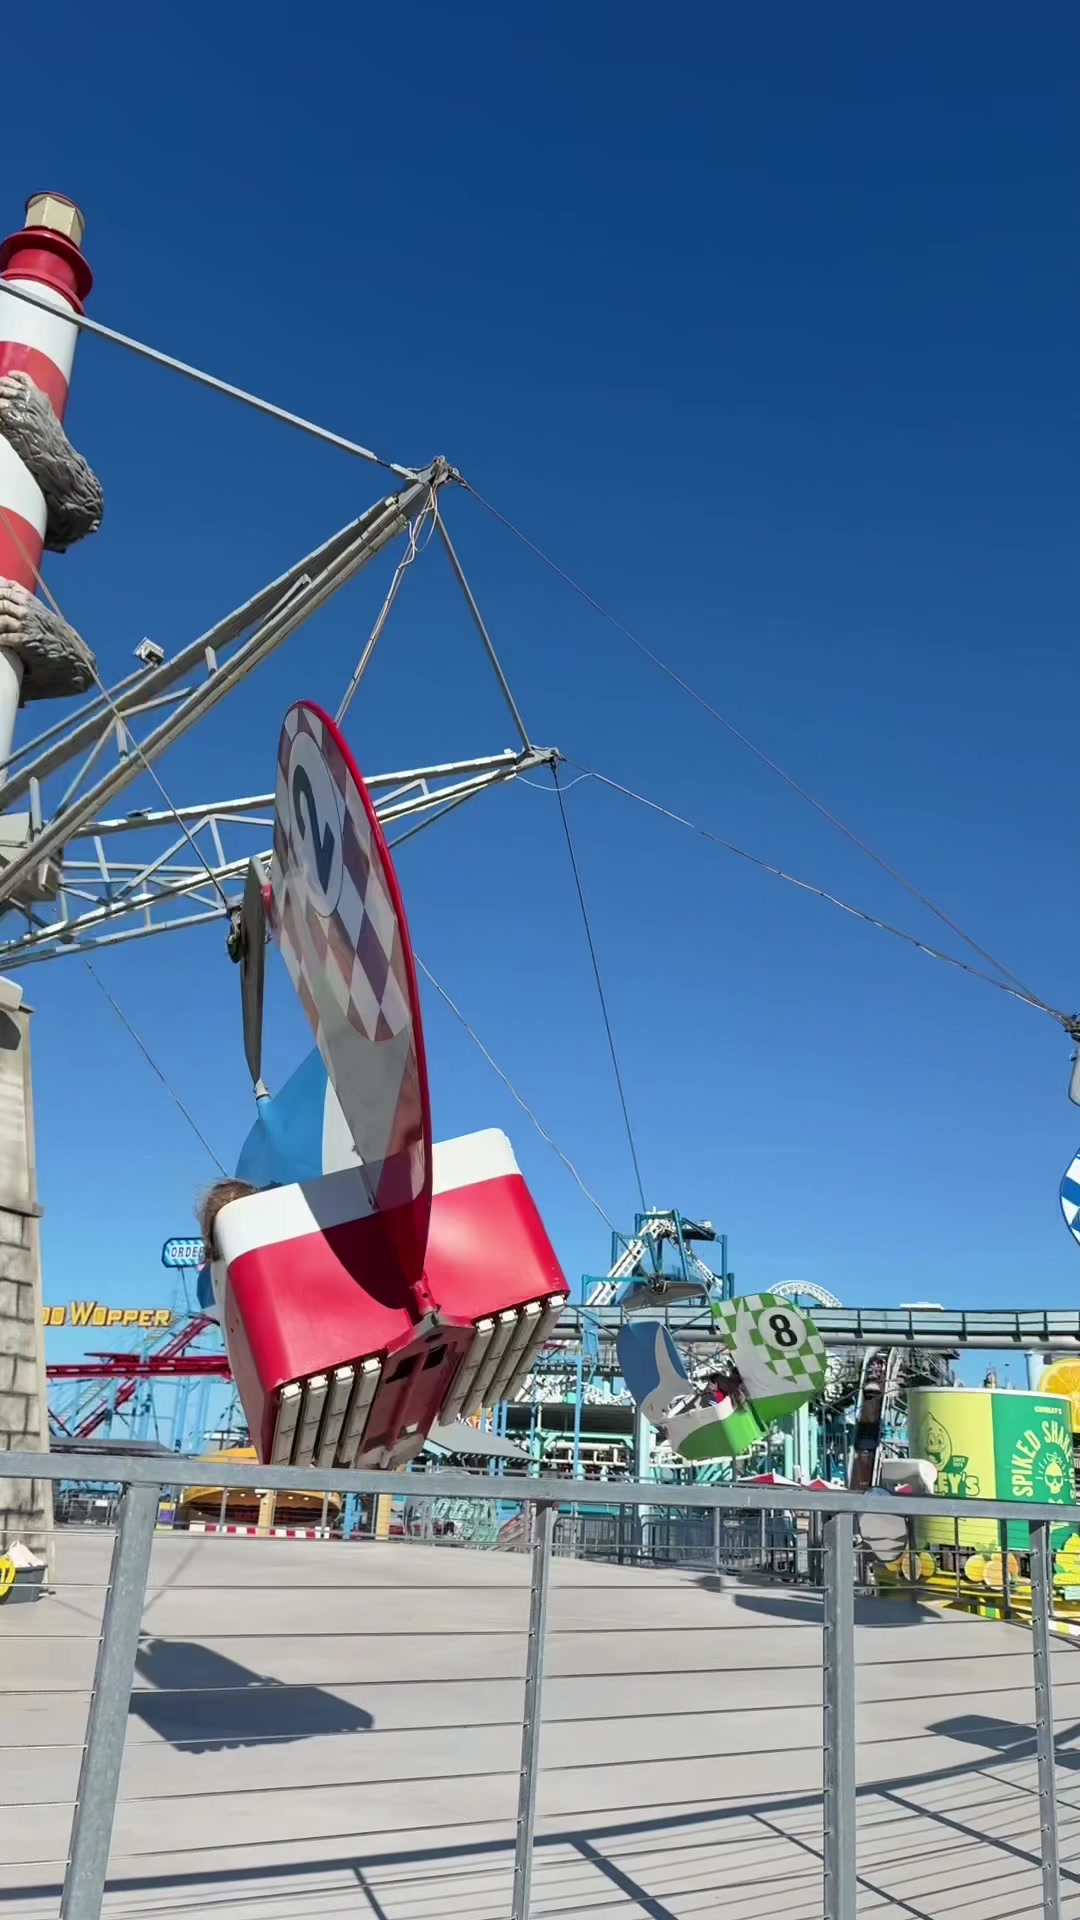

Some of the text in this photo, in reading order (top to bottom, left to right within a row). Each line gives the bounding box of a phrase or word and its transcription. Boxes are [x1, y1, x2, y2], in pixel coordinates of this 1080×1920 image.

[293, 764, 335, 895] 2
[769, 1314, 798, 1347] 8
[1011, 1429, 1041, 1497] SPIKED
